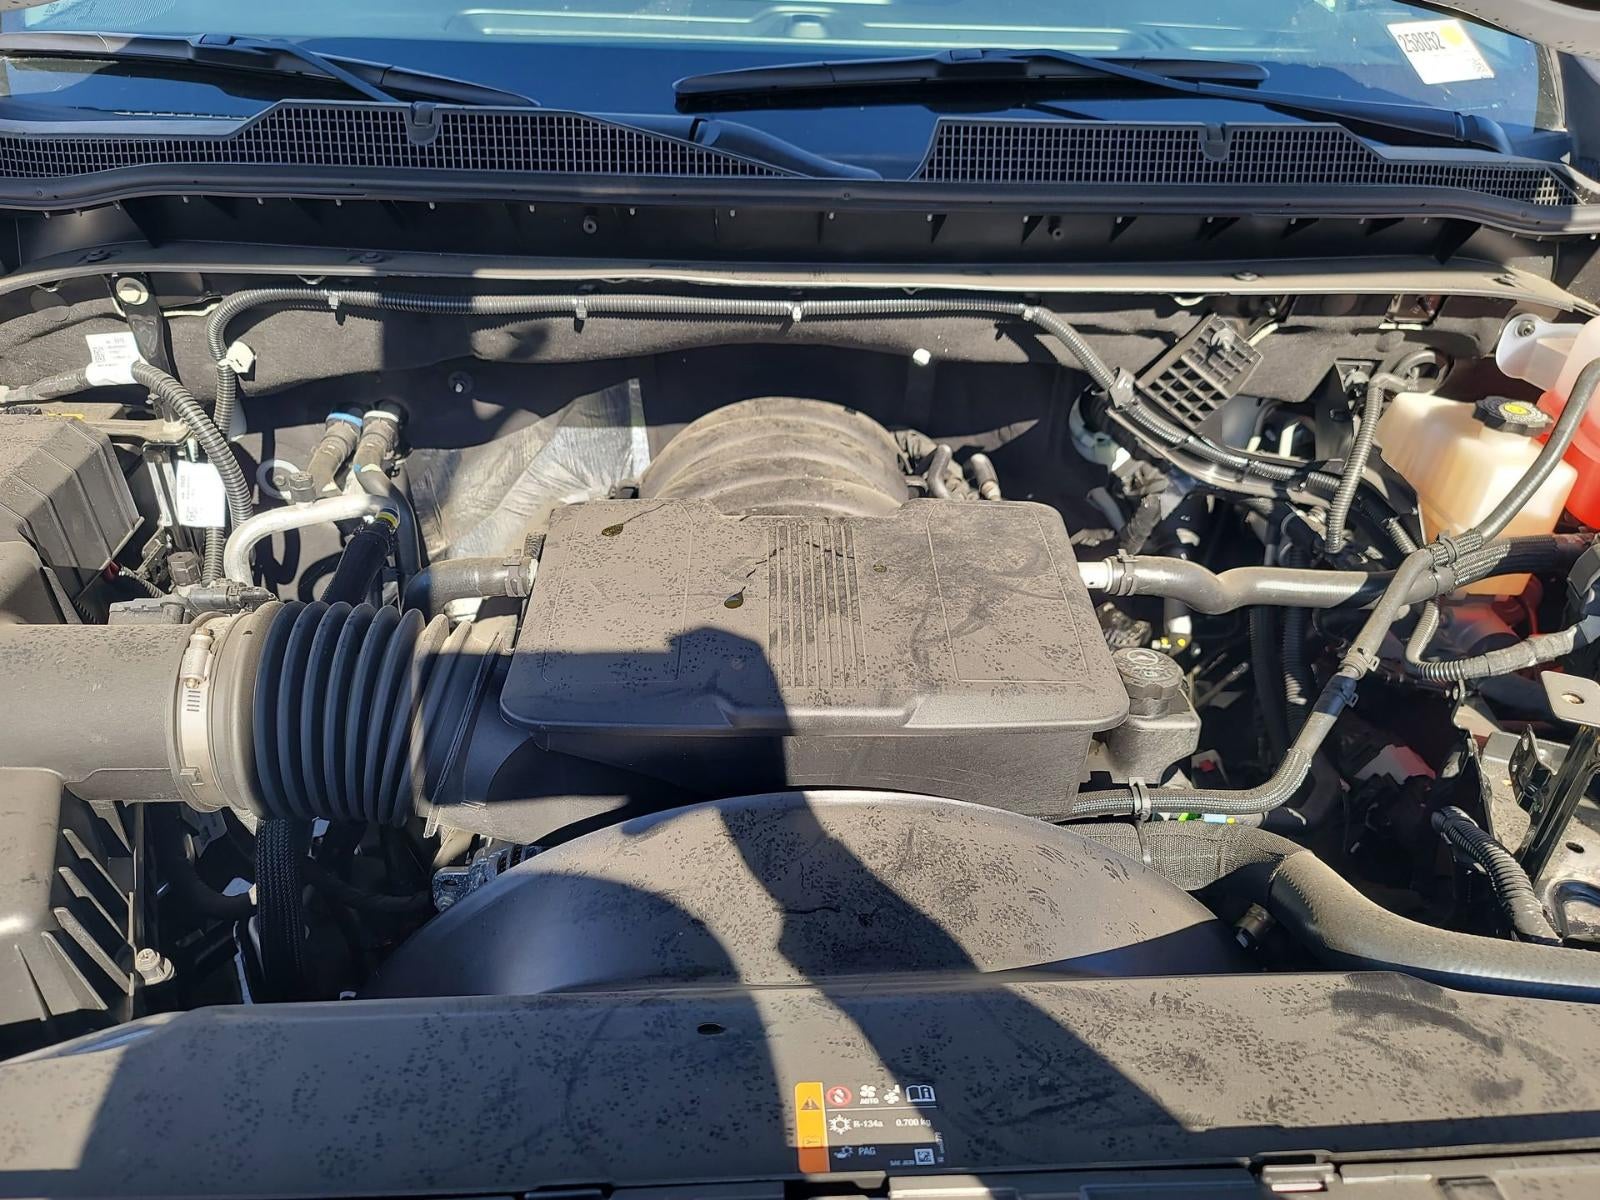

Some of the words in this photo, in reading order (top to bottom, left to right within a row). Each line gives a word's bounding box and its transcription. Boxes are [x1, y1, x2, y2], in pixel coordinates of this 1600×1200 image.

[1397, 31, 1446, 53] 258052
[853, 1120, 884, 1128] R-134a
[895, 1118, 919, 1127] 0.700
[920, 1117, 931, 1128] kg
[858, 1146, 876, 1156] PAG
